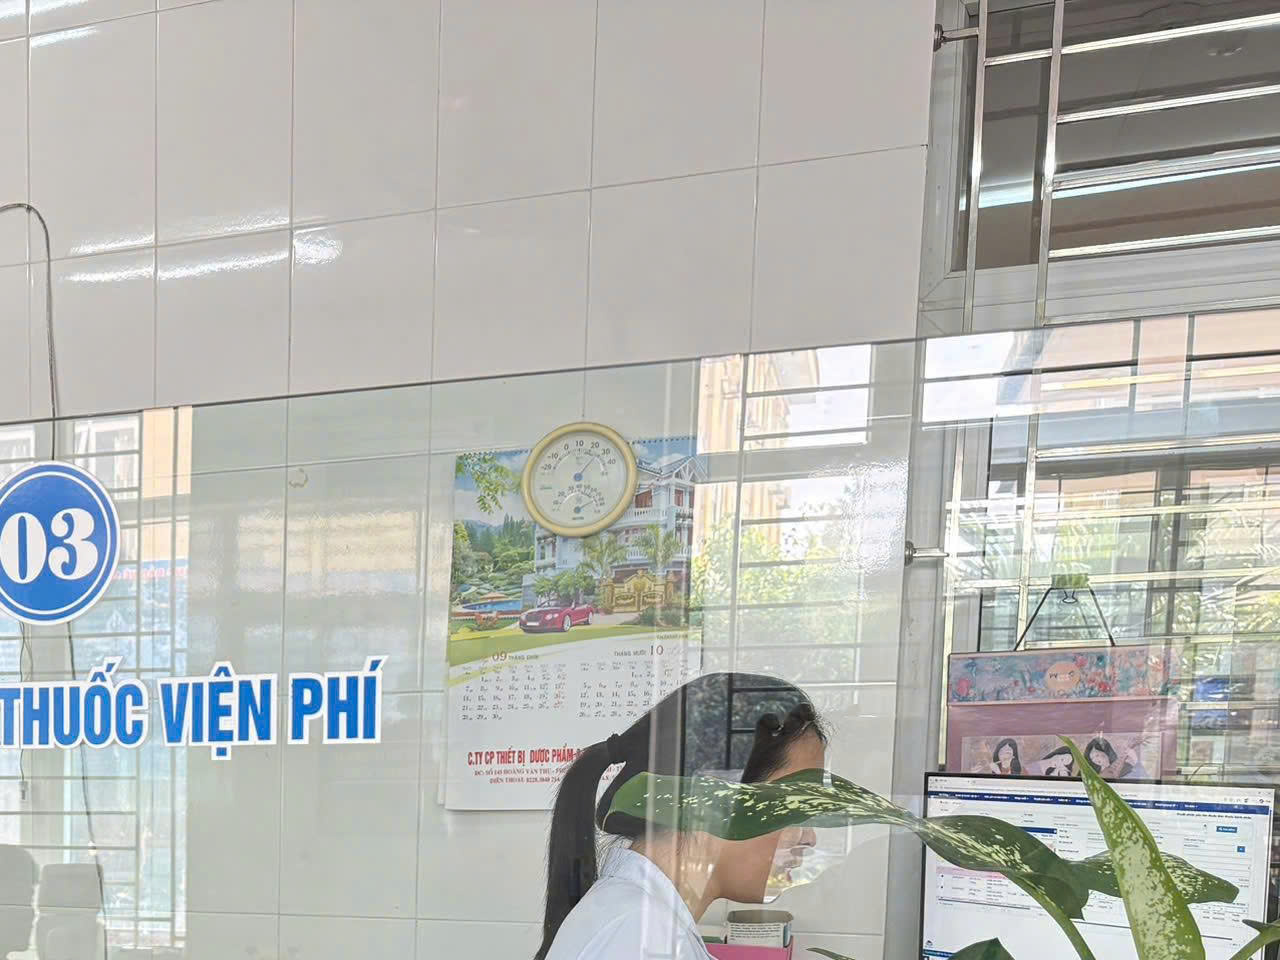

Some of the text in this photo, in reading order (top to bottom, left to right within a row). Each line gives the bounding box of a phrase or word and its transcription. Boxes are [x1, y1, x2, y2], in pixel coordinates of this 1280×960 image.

[492, 651, 507, 661] 09
[650, 645, 664, 656] 10
[158, 661, 277, 759] VIỆN
[288, 655, 389, 745] PHÍ
[468, 752, 483, 765] C.TY
[484, 751, 495, 765] CP
[496, 746, 516, 764] THIẾT
[518, 750, 526, 766] BỊ
[530, 749, 550, 766] DƯỢC
